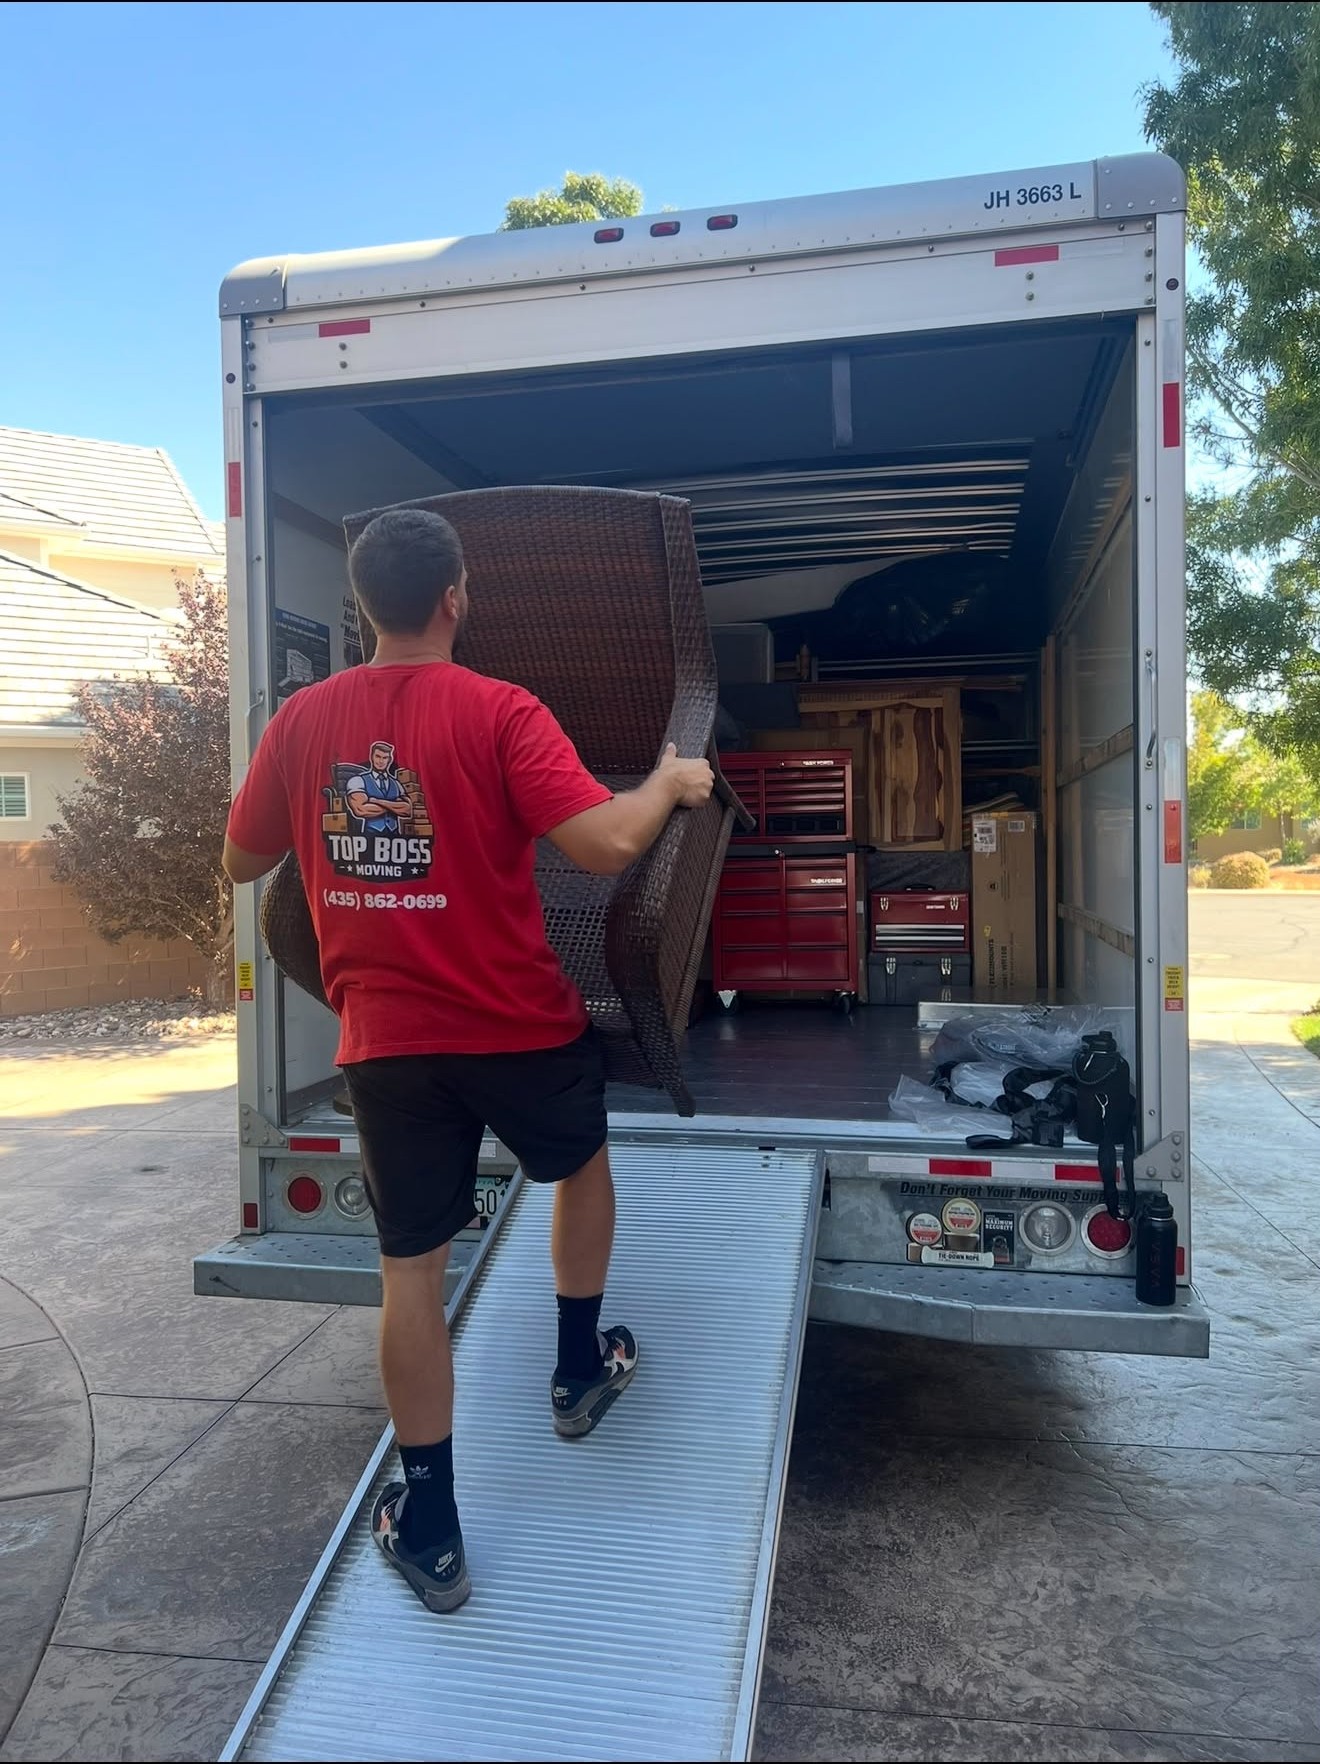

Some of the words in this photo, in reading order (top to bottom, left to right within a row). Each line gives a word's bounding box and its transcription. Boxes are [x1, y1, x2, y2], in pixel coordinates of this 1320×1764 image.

[984, 190, 1010, 210] JH
[1016, 184, 1064, 206] 3663
[1069, 182, 1082, 200] L
[328, 835, 368, 862] TOP
[374, 836, 432, 865] BOSS
[356, 864, 402, 877] MOVING
[323, 888, 360, 911] (435)
[363, 893, 448, 910] 862-0699
[474, 1188, 506, 1216] 50
[900, 1181, 936, 1195] Don't
[940, 1183, 983, 1198] Forget
[985, 1185, 1017, 1198] Your
[1019, 1187, 1068, 1202] Moving
